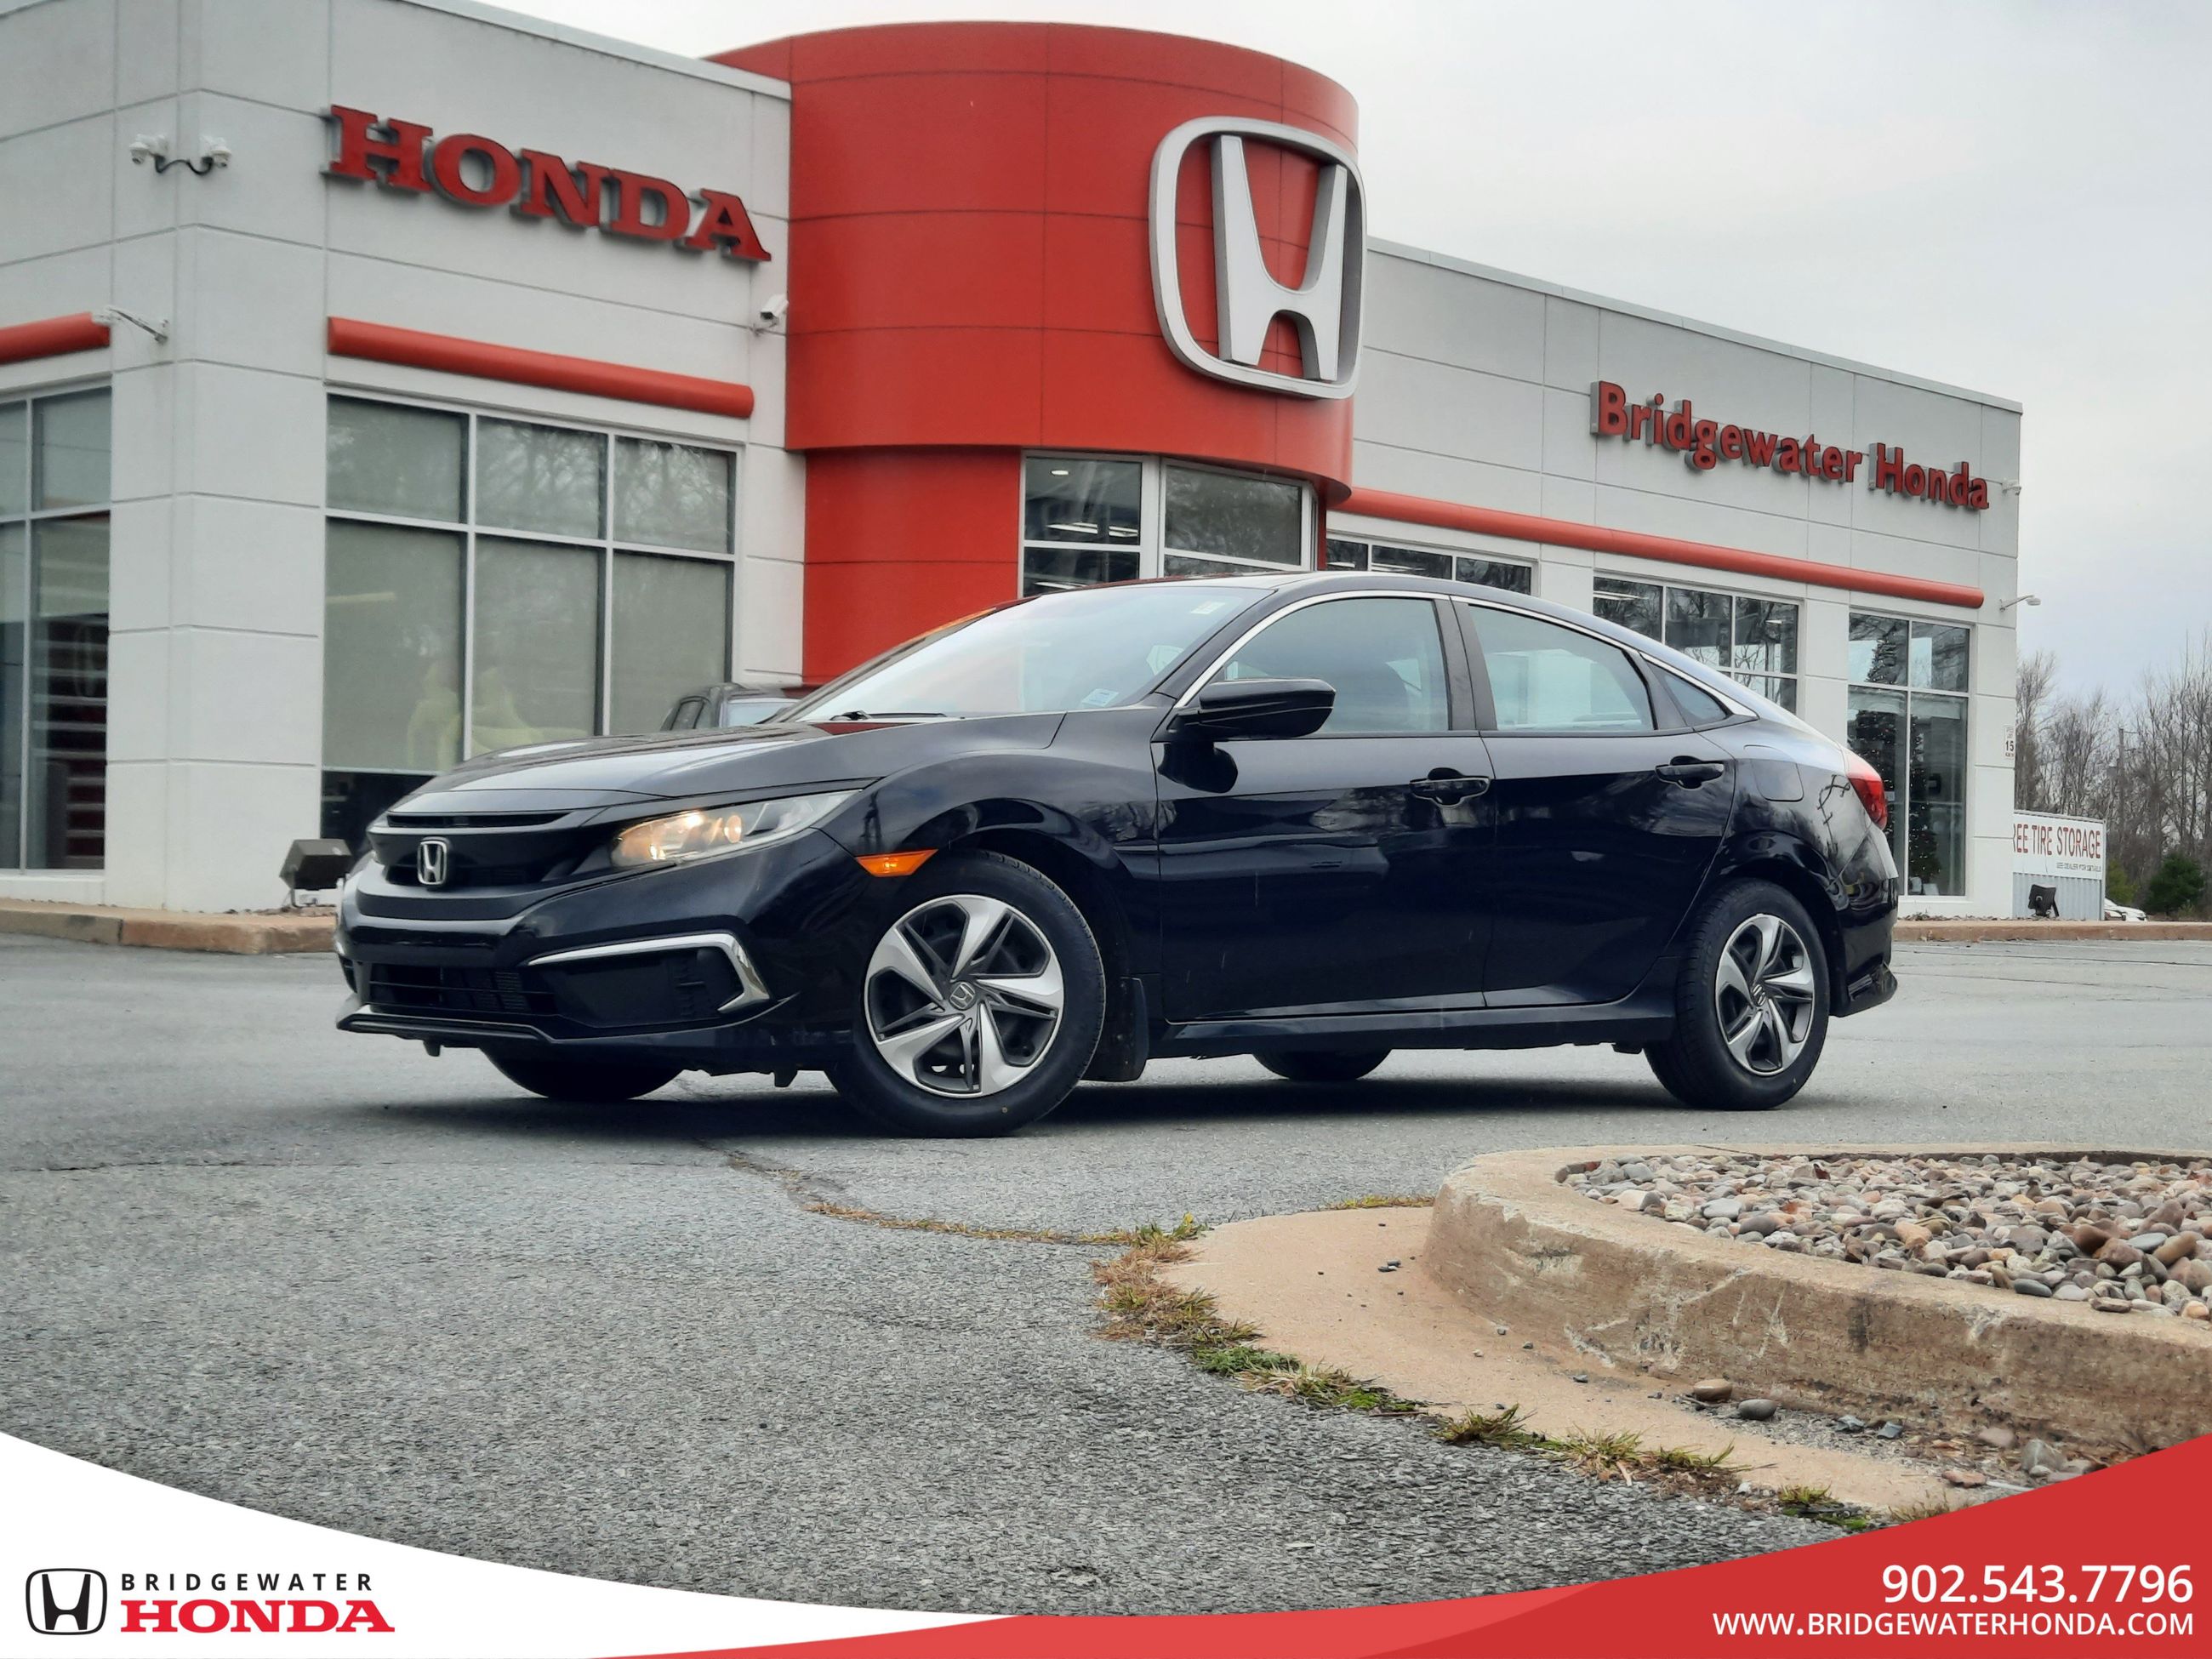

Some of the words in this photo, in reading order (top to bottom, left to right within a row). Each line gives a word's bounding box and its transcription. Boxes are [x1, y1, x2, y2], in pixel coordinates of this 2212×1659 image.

[328, 104, 772, 262] HONDA
[1593, 379, 1864, 483] Bridgewater
[1871, 442, 1991, 510] Honda
[2005, 740, 2015, 752] 15
[2032, 824, 2053, 856] TIRE
[2056, 826, 2101, 859] STORAGE
